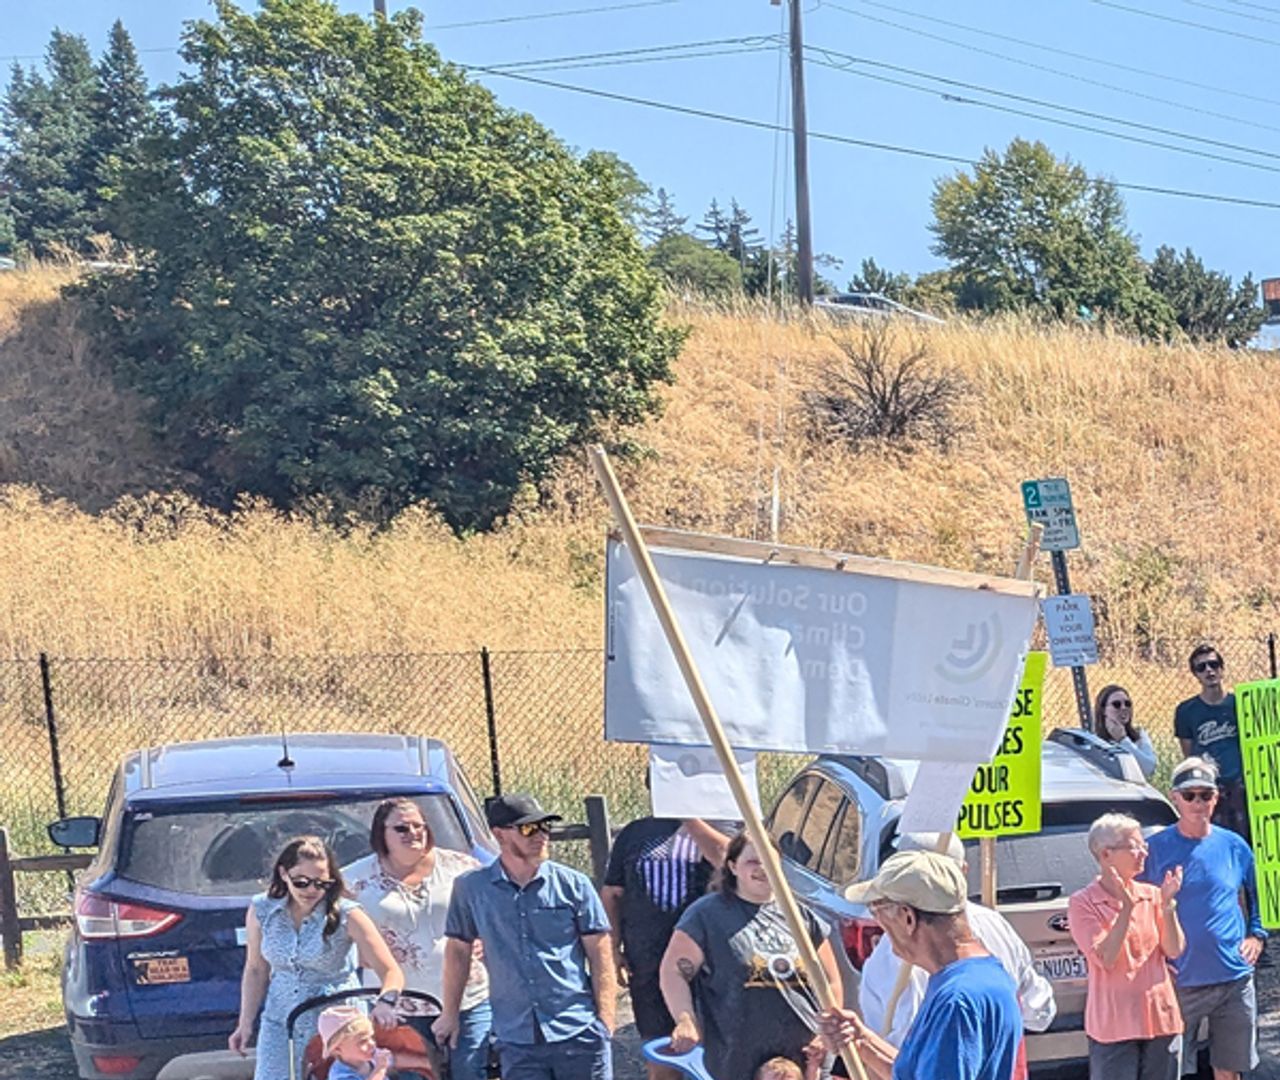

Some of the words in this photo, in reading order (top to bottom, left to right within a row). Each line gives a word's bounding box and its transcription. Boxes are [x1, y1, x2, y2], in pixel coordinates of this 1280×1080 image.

[1026, 487, 1038, 505] 2
[1056, 603, 1080, 612] PARK
[1064, 614, 1074, 622] AT
[1060, 624, 1083, 633] YOUR
[971, 764, 1009, 794] OUR
[957, 799, 1023, 832] PULSES
